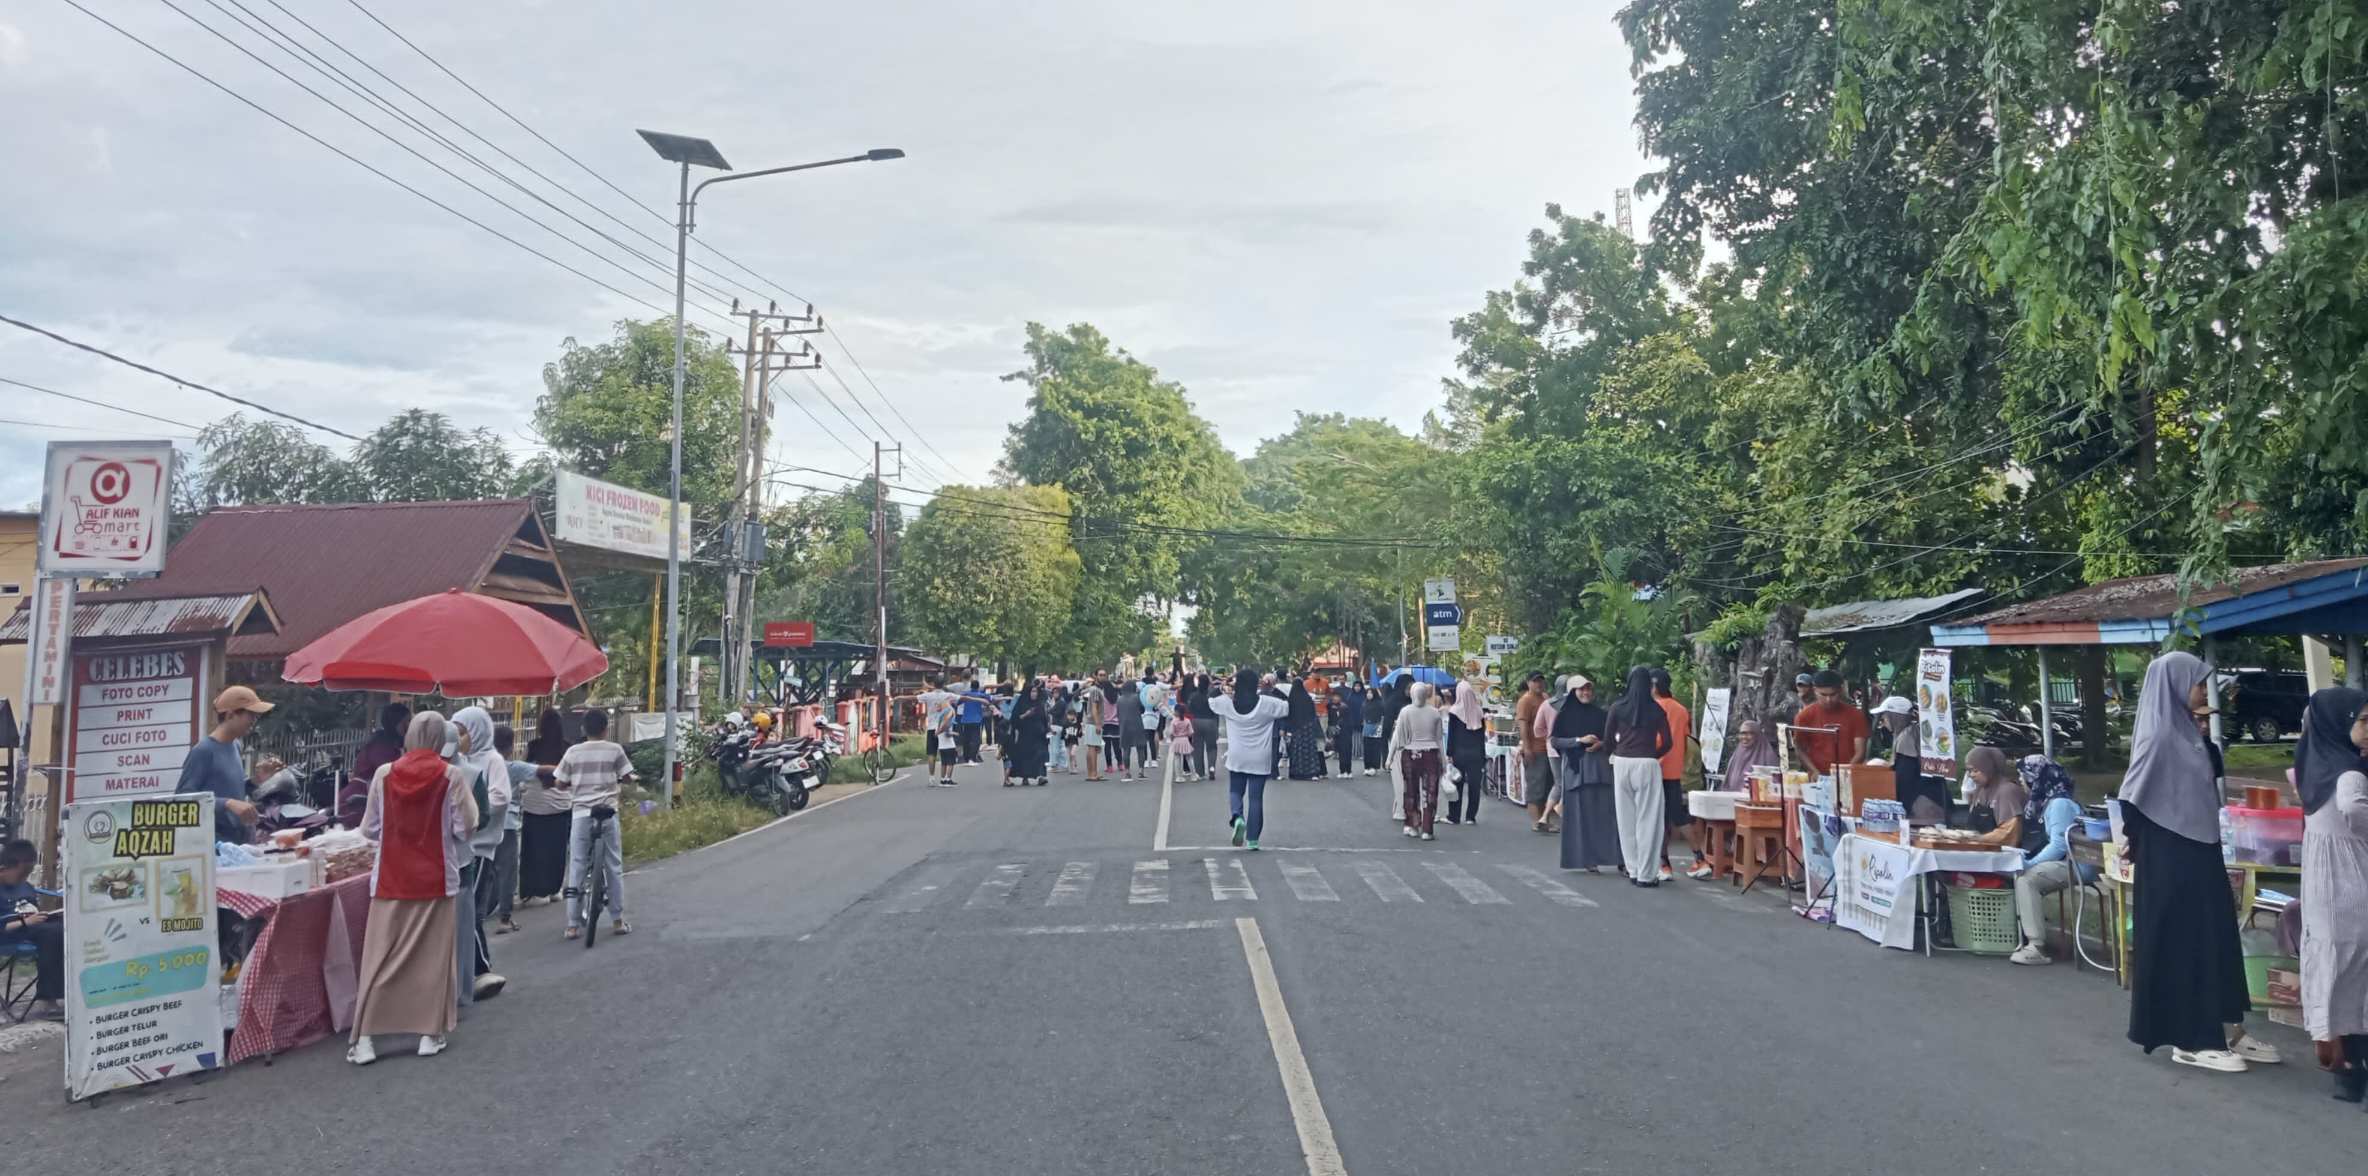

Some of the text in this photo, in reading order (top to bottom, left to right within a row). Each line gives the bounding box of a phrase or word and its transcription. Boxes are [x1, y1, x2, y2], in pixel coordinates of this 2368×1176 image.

[86, 507, 140, 519] ALIF KIAN
[103, 521, 140, 533] mart
[1432, 610, 1453, 618] atm
[89, 651, 185, 681] CELEBES
[102, 684, 169, 700] FOTO COPY
[116, 708, 152, 722] PRINT
[102, 730, 167, 746] CUCI FOTO
[117, 754, 150, 767] SCAN
[105, 777, 159, 791] MATERAI
[133, 803, 198, 827] BURGER
[115, 830, 173, 857] AQZAH
[173, 919, 203, 932] MOJITO
[126, 961, 149, 980] Rp
[95, 1000, 182, 1024] BURGER CRISPY BEEF
[96, 1020, 157, 1040] BURGER TELUR
[96, 1033, 168, 1056] BURGER BEEF ORI
[96, 1041, 204, 1071] BURGER CRISPY CHICKEN
